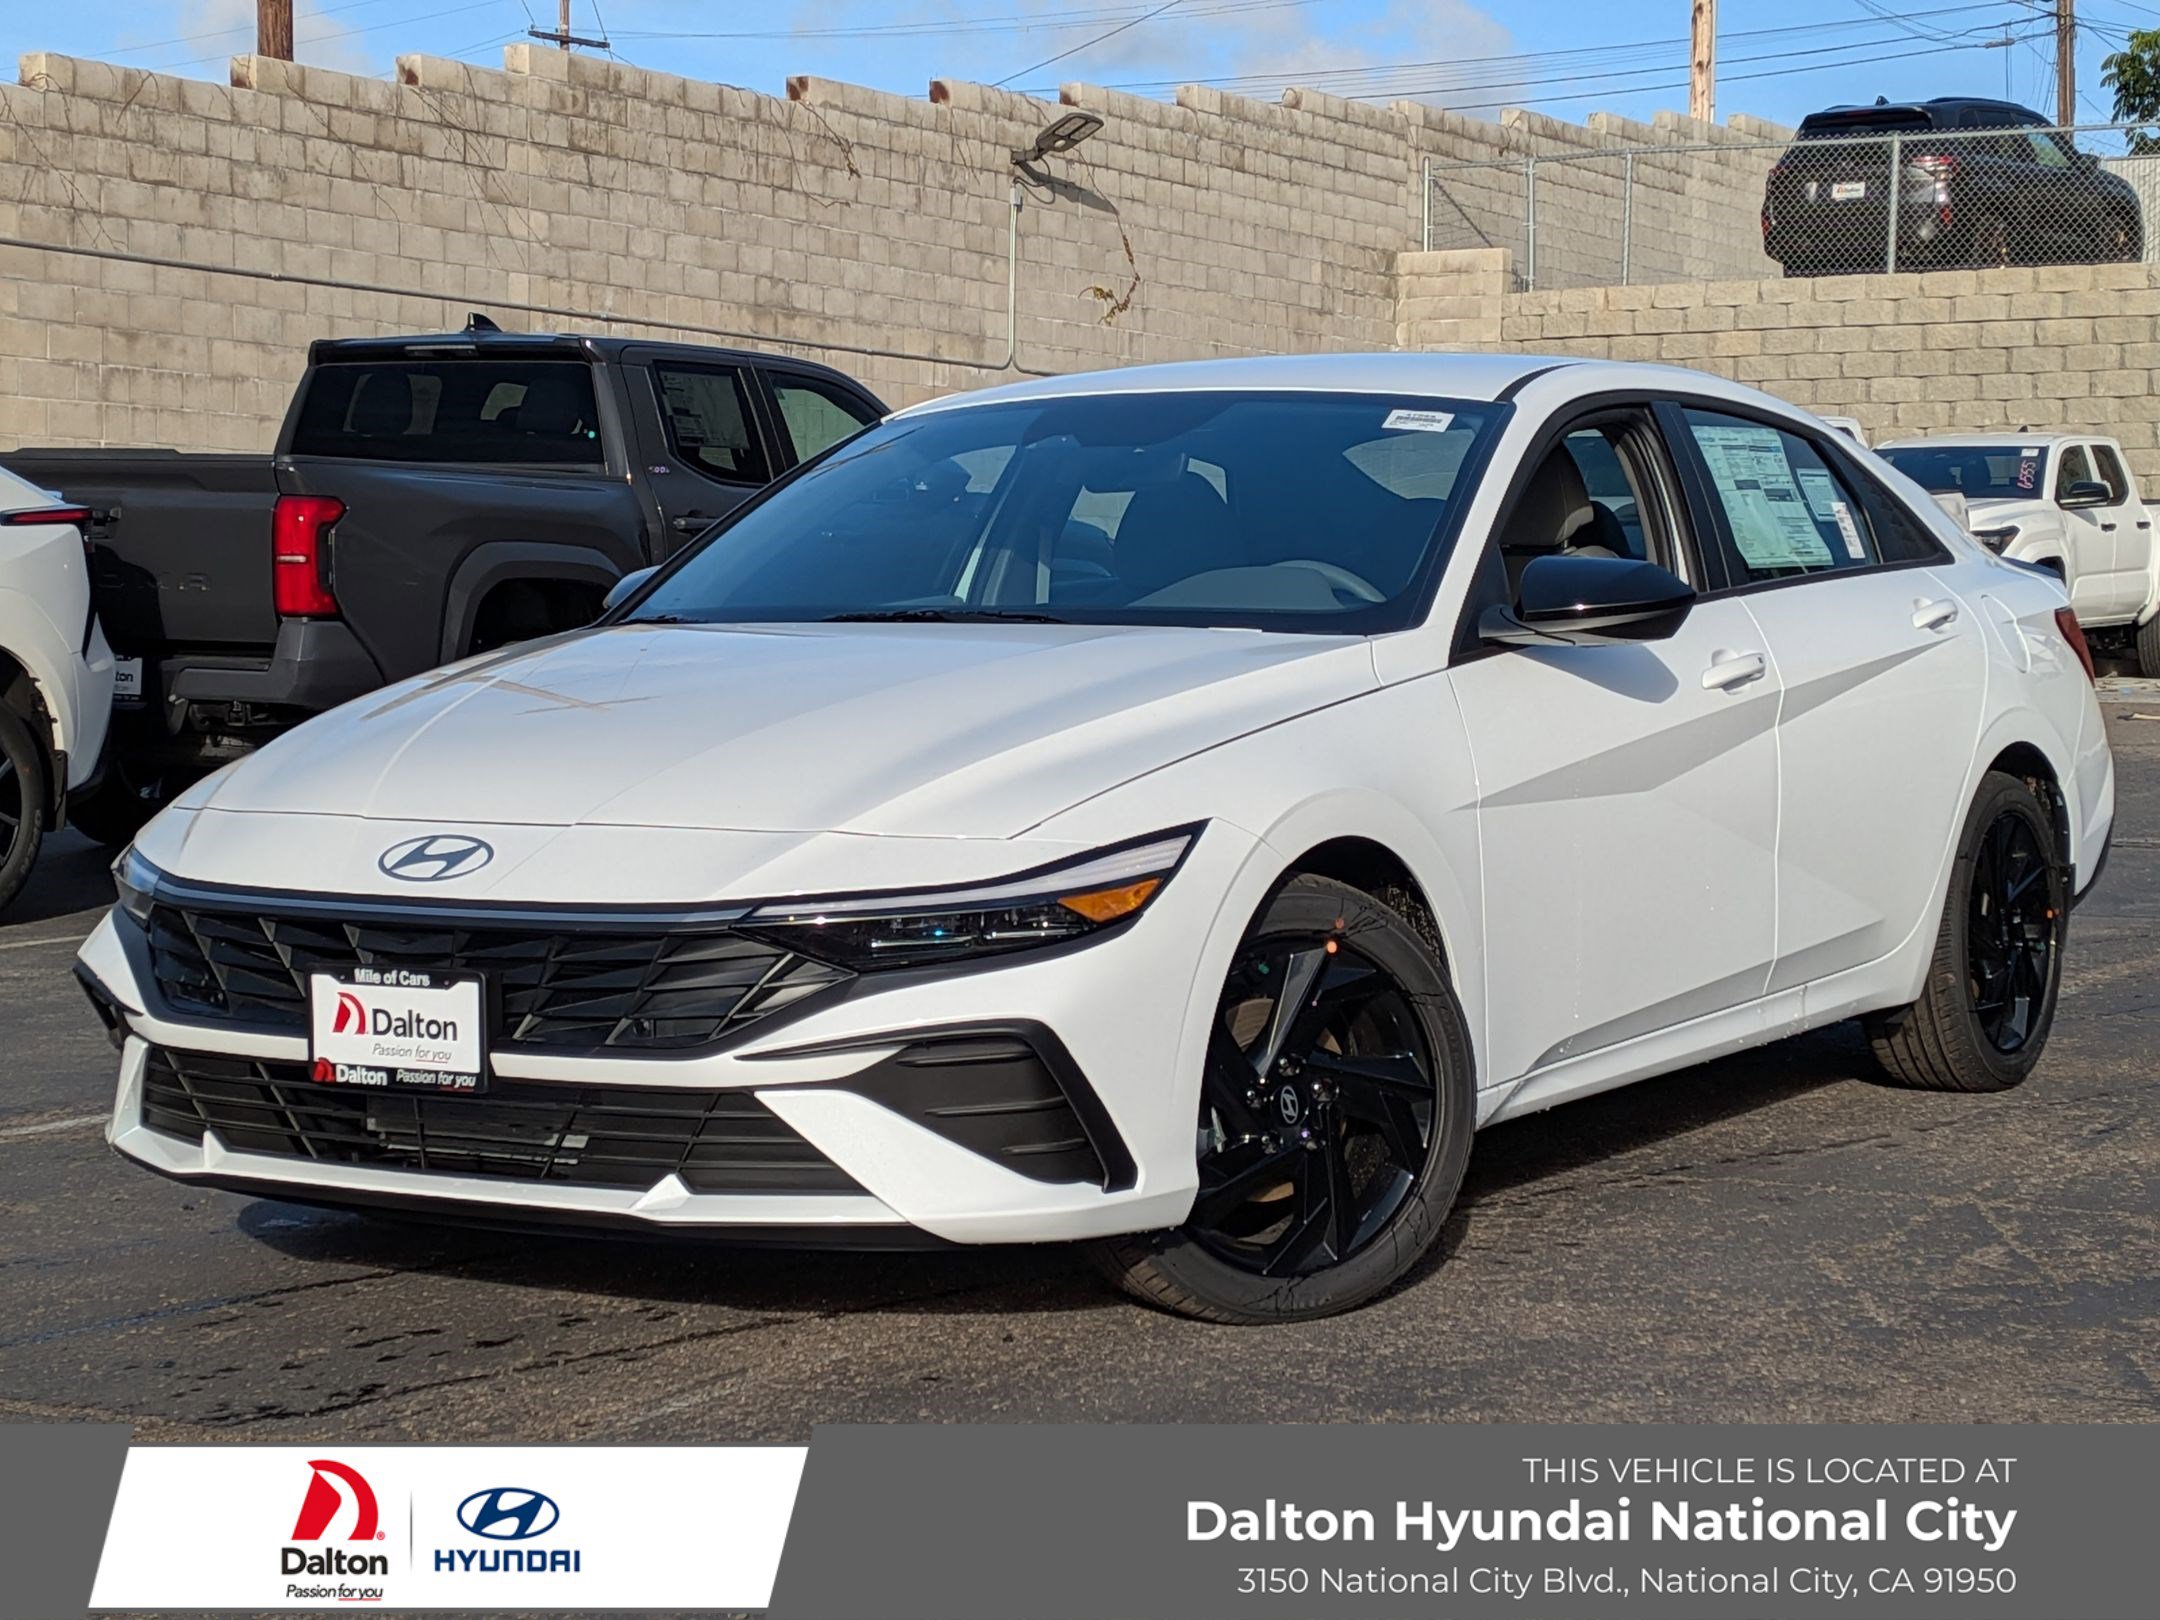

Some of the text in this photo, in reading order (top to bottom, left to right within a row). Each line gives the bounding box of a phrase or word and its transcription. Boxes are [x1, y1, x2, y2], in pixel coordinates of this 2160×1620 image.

[354, 968, 430, 987] Mile of Cars
[372, 1008, 458, 1041] Dalton
[372, 1043, 452, 1062] Passion for you
[336, 1065, 476, 1088] Dalton Passion for you
